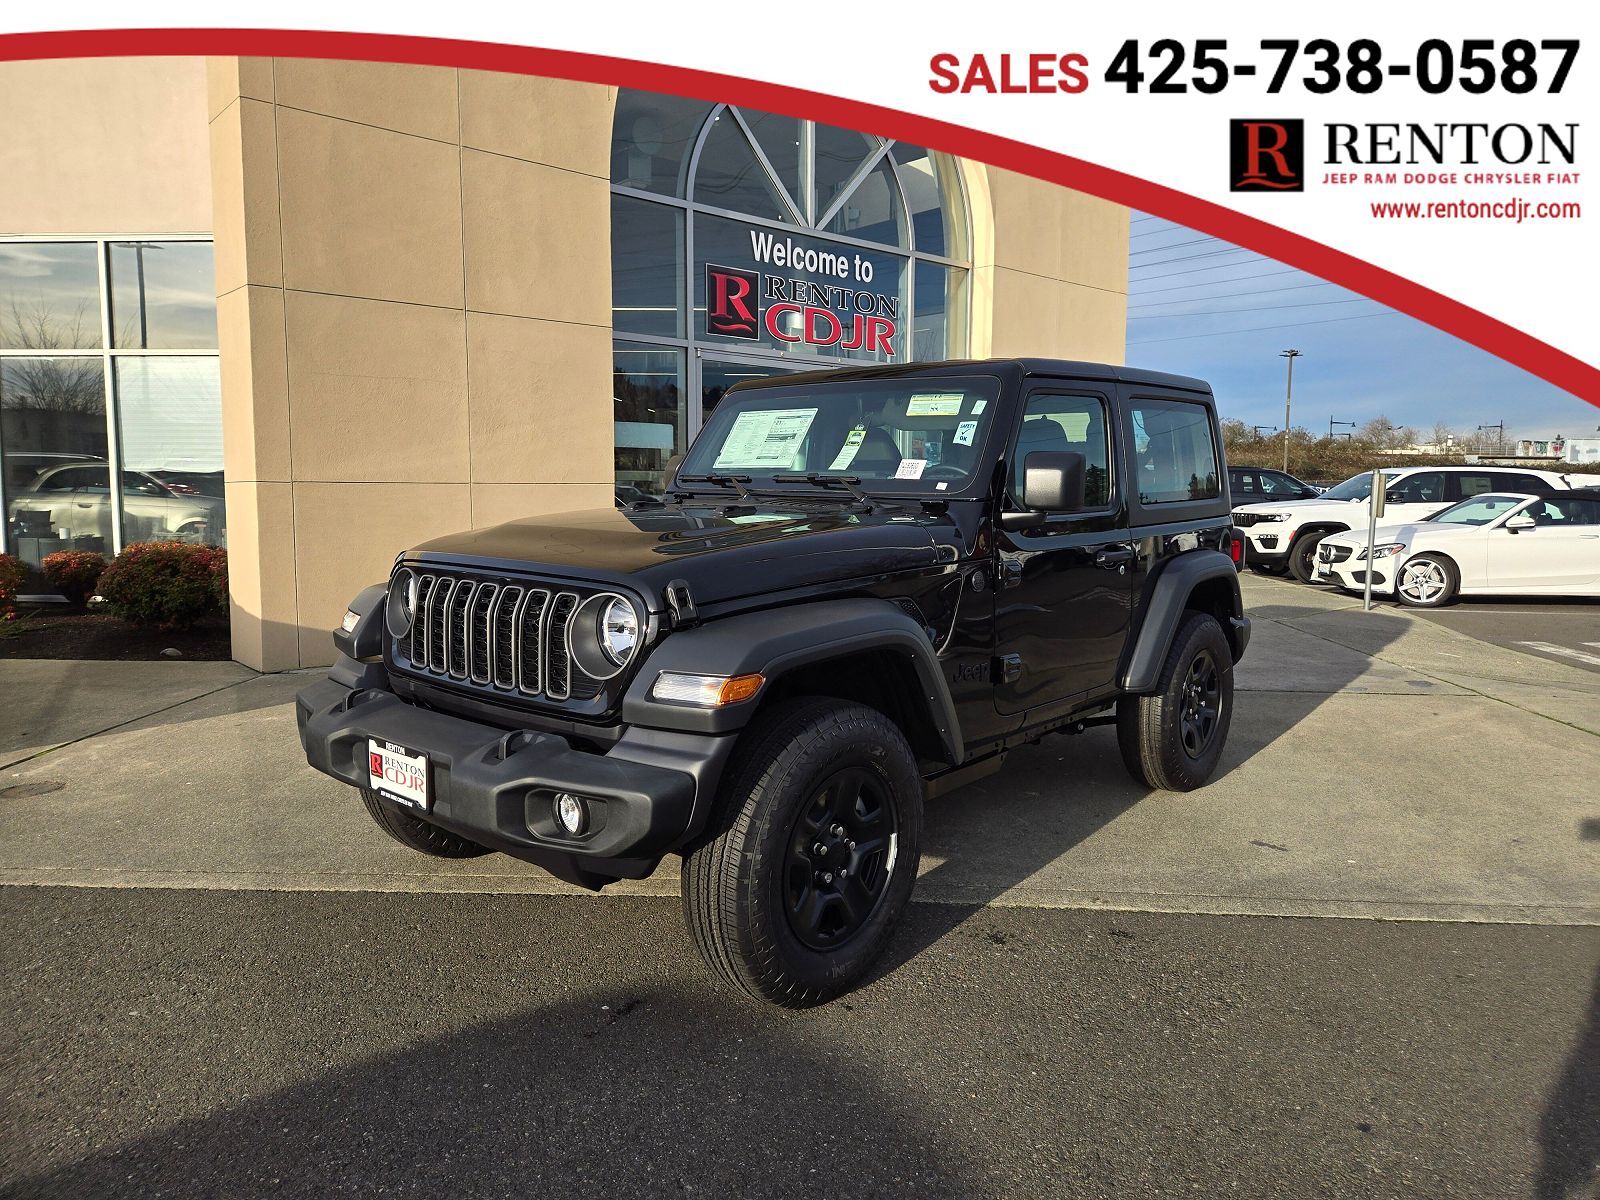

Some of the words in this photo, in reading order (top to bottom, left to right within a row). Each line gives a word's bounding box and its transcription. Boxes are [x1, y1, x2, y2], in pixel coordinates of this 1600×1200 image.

[750, 230, 849, 278] Welcome
[854, 254, 873, 283] to
[765, 274, 899, 318] RENTON
[765, 303, 896, 356] CDJR
[953, 662, 989, 682] Jeep
[385, 742, 405, 755] RENTON
[384, 756, 424, 778] RENTON
[384, 767, 424, 793] CDJR
